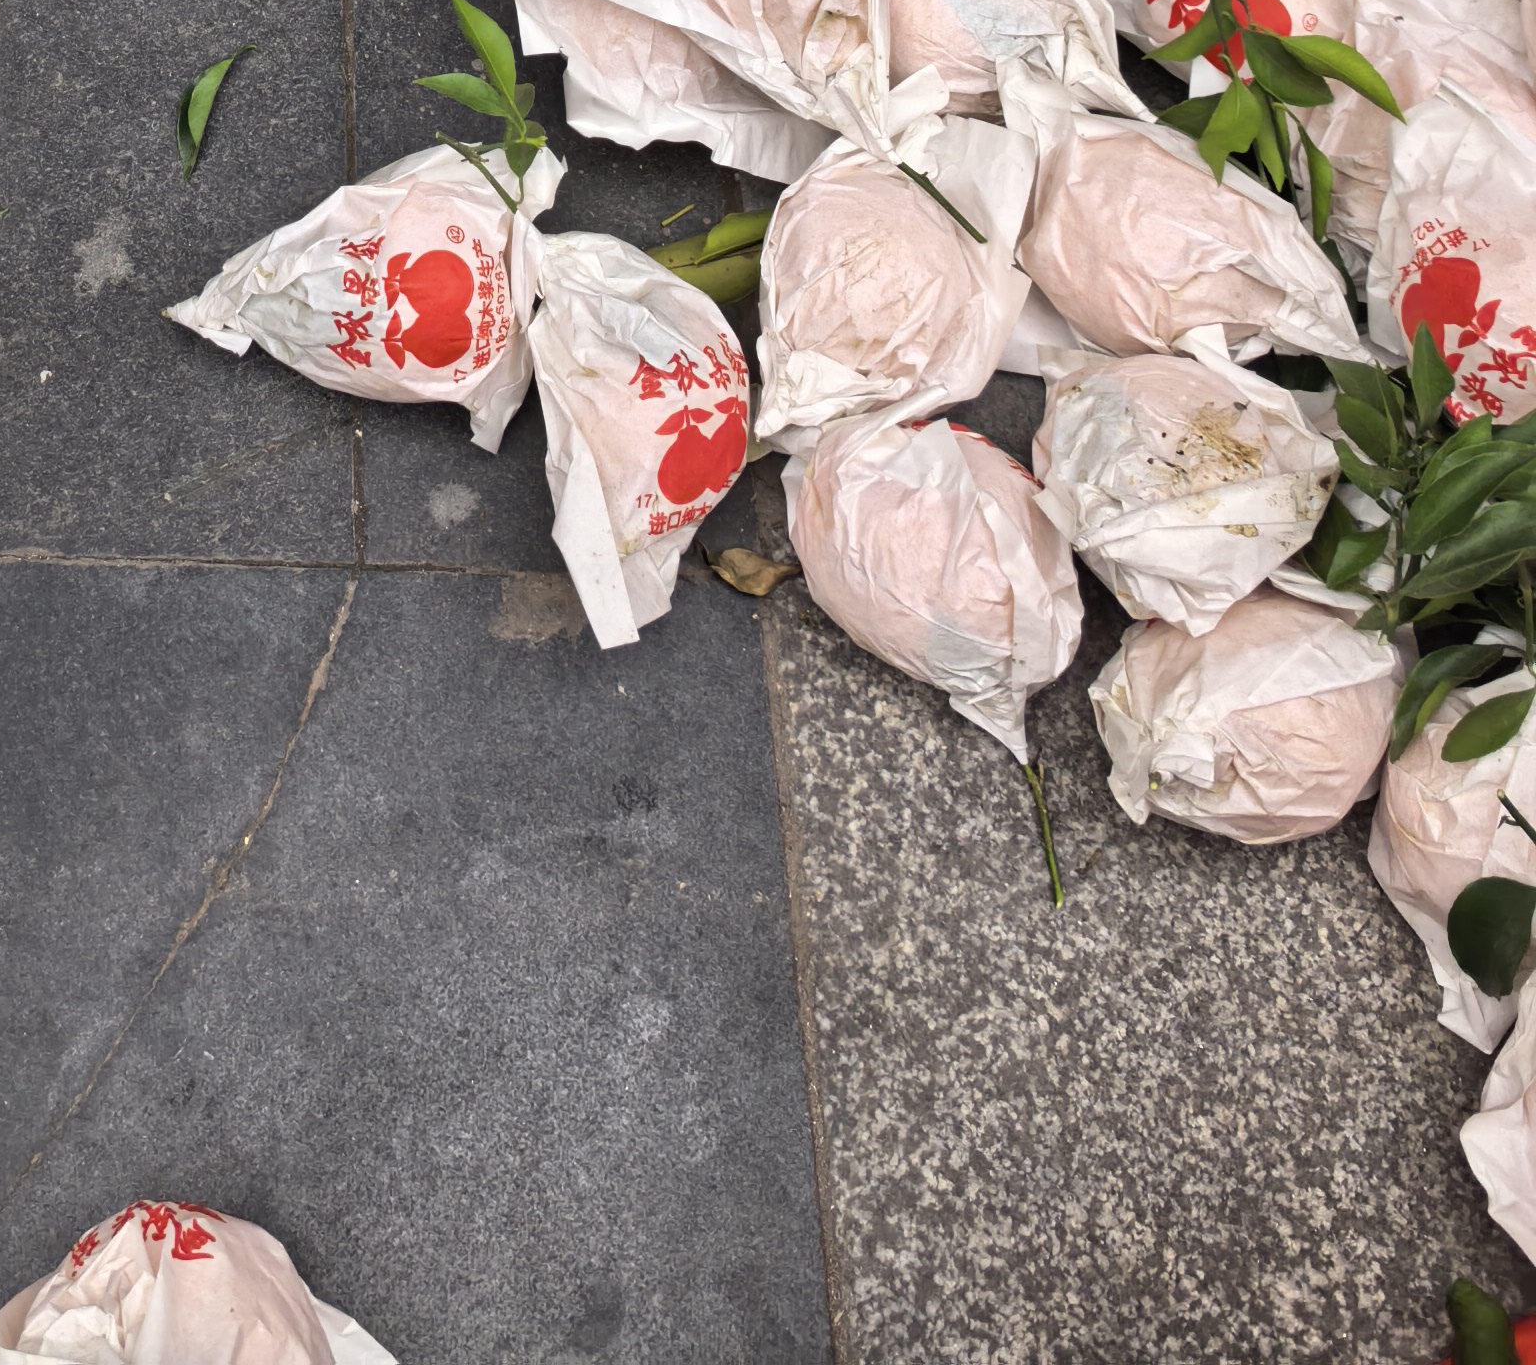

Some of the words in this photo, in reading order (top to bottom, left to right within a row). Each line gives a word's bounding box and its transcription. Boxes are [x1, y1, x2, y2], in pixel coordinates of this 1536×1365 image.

[327, 235, 387, 370] 金秋果袋
[454, 368, 469, 383] 17
[635, 494, 654, 508] 17
